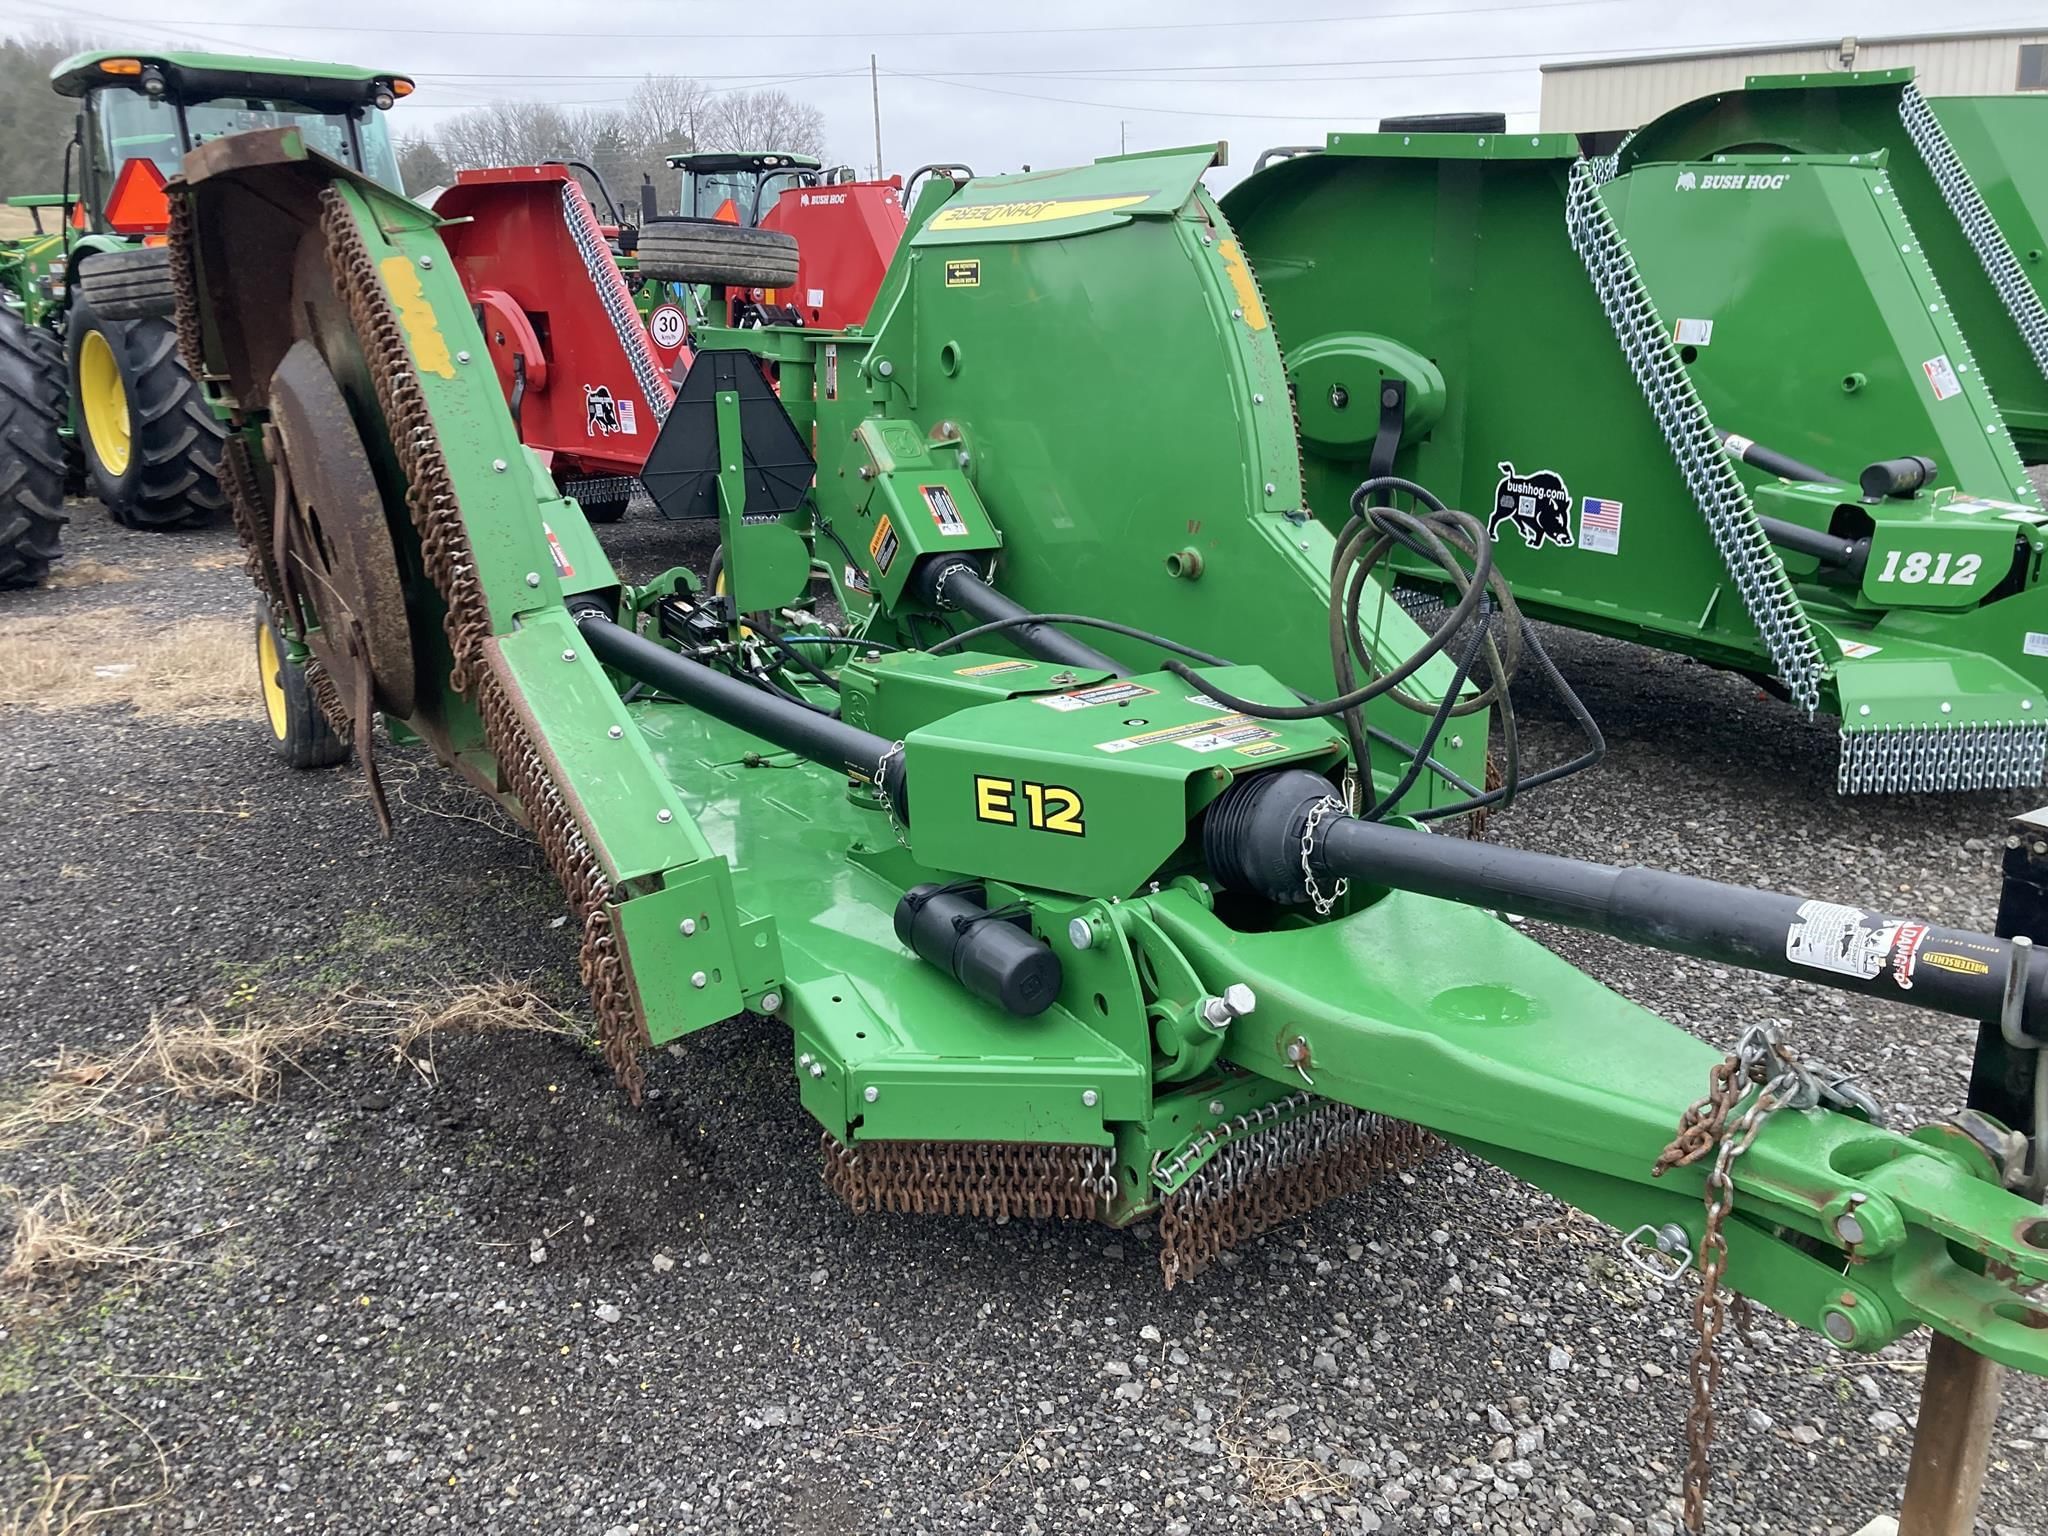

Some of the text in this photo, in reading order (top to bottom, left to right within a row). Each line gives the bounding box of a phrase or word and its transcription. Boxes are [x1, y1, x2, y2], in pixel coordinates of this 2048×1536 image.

[1700, 175, 1745, 189] BUSH
[811, 195, 829, 205] BUSH
[945, 201, 1056, 222] JOHN DEERE
[660, 316, 677, 332] 30
[1507, 480, 1565, 500] bushhog.com
[1878, 551, 1982, 585] 1812
[1922, 952, 1989, 975] WALTERSCHEID
